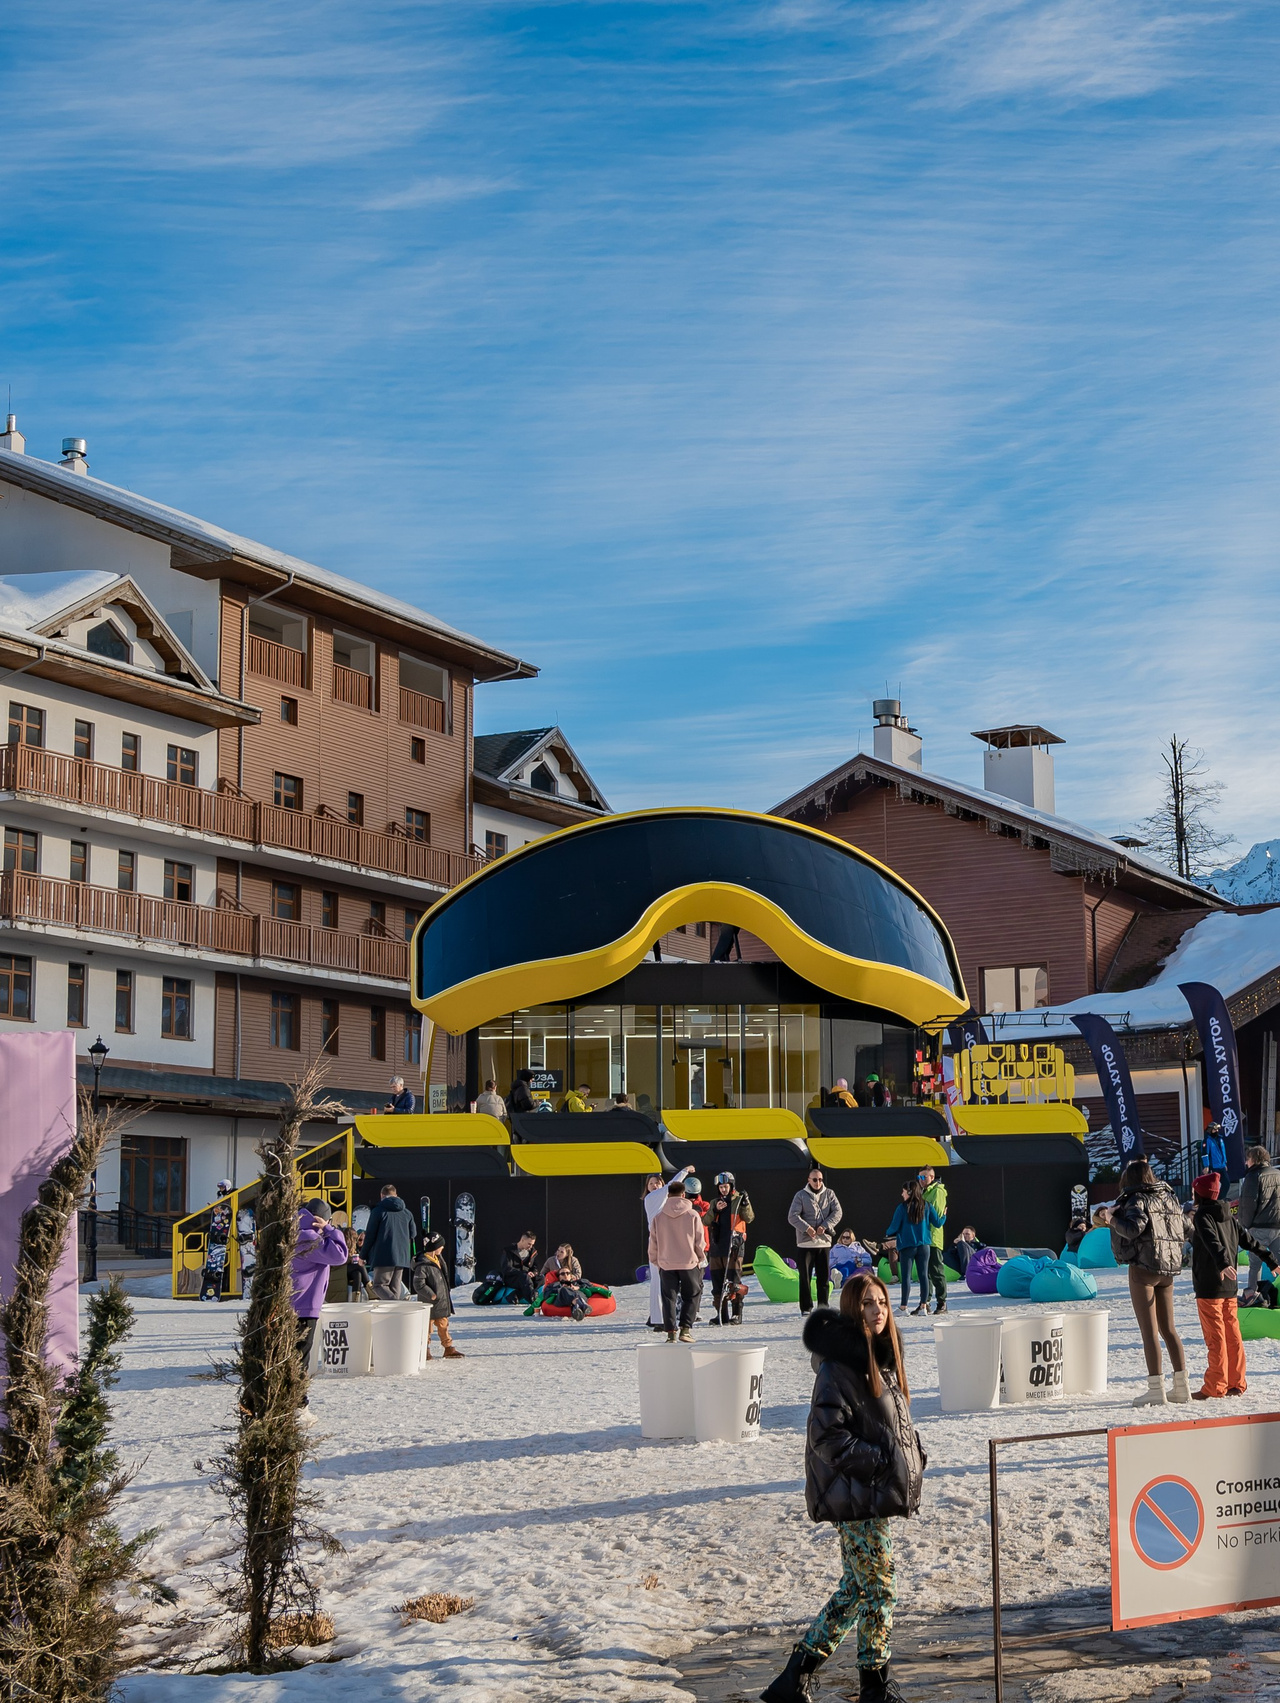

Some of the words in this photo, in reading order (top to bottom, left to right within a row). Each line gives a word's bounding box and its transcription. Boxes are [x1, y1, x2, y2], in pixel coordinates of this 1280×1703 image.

[1209, 1016, 1227, 1064] ХУТОР
[1101, 1043, 1121, 1087] ХУТОР
[529, 1081, 558, 1089] ВЕСТ
[531, 1073, 555, 1081] ОЗА
[1218, 1064, 1232, 1104] РОЗА
[432, 1090, 440, 1098] 25
[432, 1098, 446, 1108] ВМЕ
[1115, 1086, 1128, 1123] РОЗА
[322, 1329, 349, 1347] ОЗА
[324, 1347, 350, 1365] ЕСТ
[749, 1374, 763, 1400] РО
[1025, 1391, 1046, 1399] ВМЕСТЕ
[745, 1399, 762, 1426] Ф
[1215, 1476, 1280, 1495] Стоянка
[1217, 1533, 1239, 1550] No
